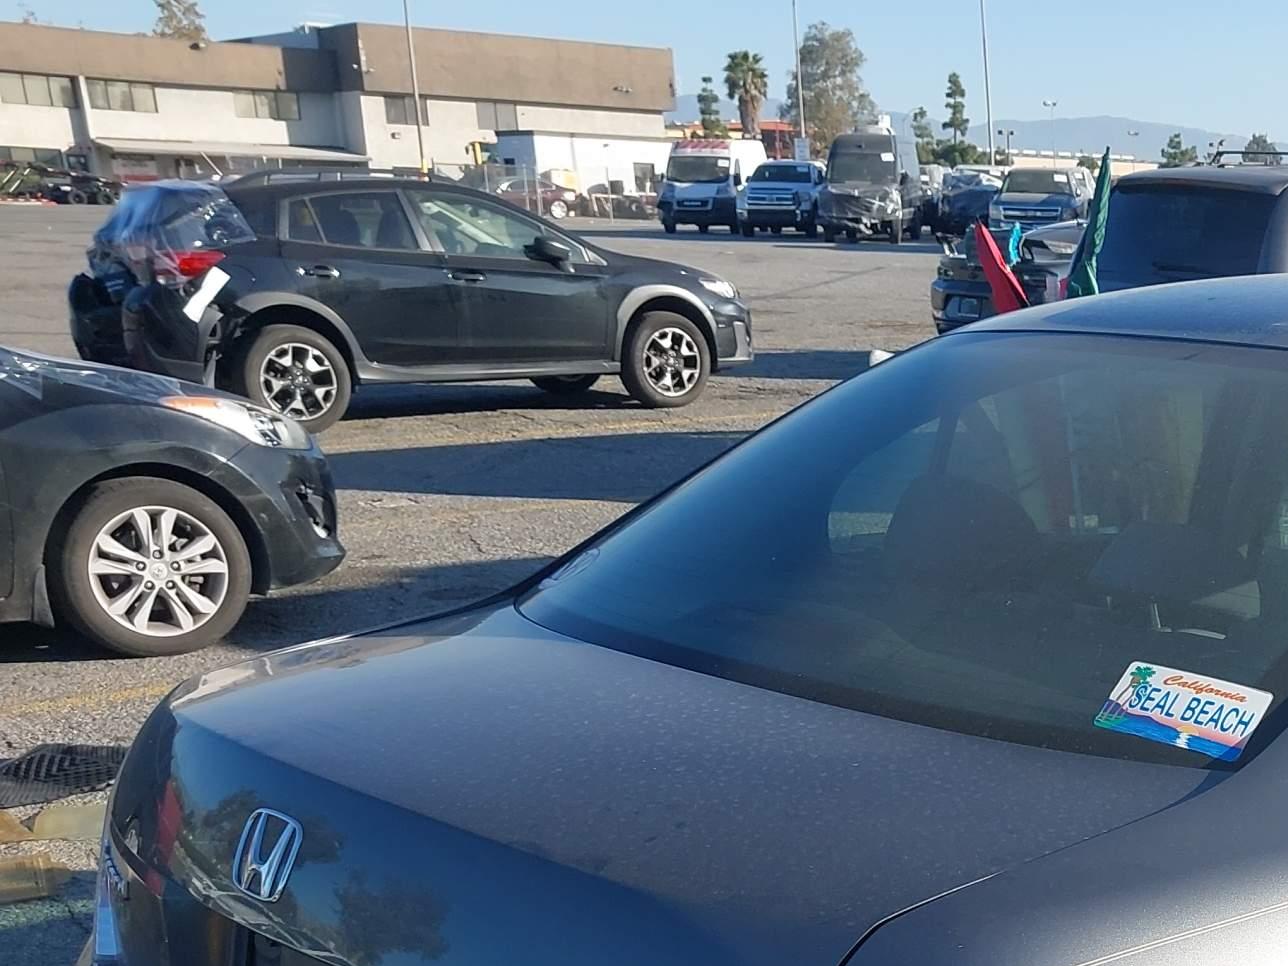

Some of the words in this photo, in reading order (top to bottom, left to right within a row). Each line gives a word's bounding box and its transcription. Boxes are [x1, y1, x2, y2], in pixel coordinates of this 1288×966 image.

[1163, 674, 1249, 703] California
[1128, 683, 1181, 718] SEAL
[1180, 696, 1255, 738] BEACH
